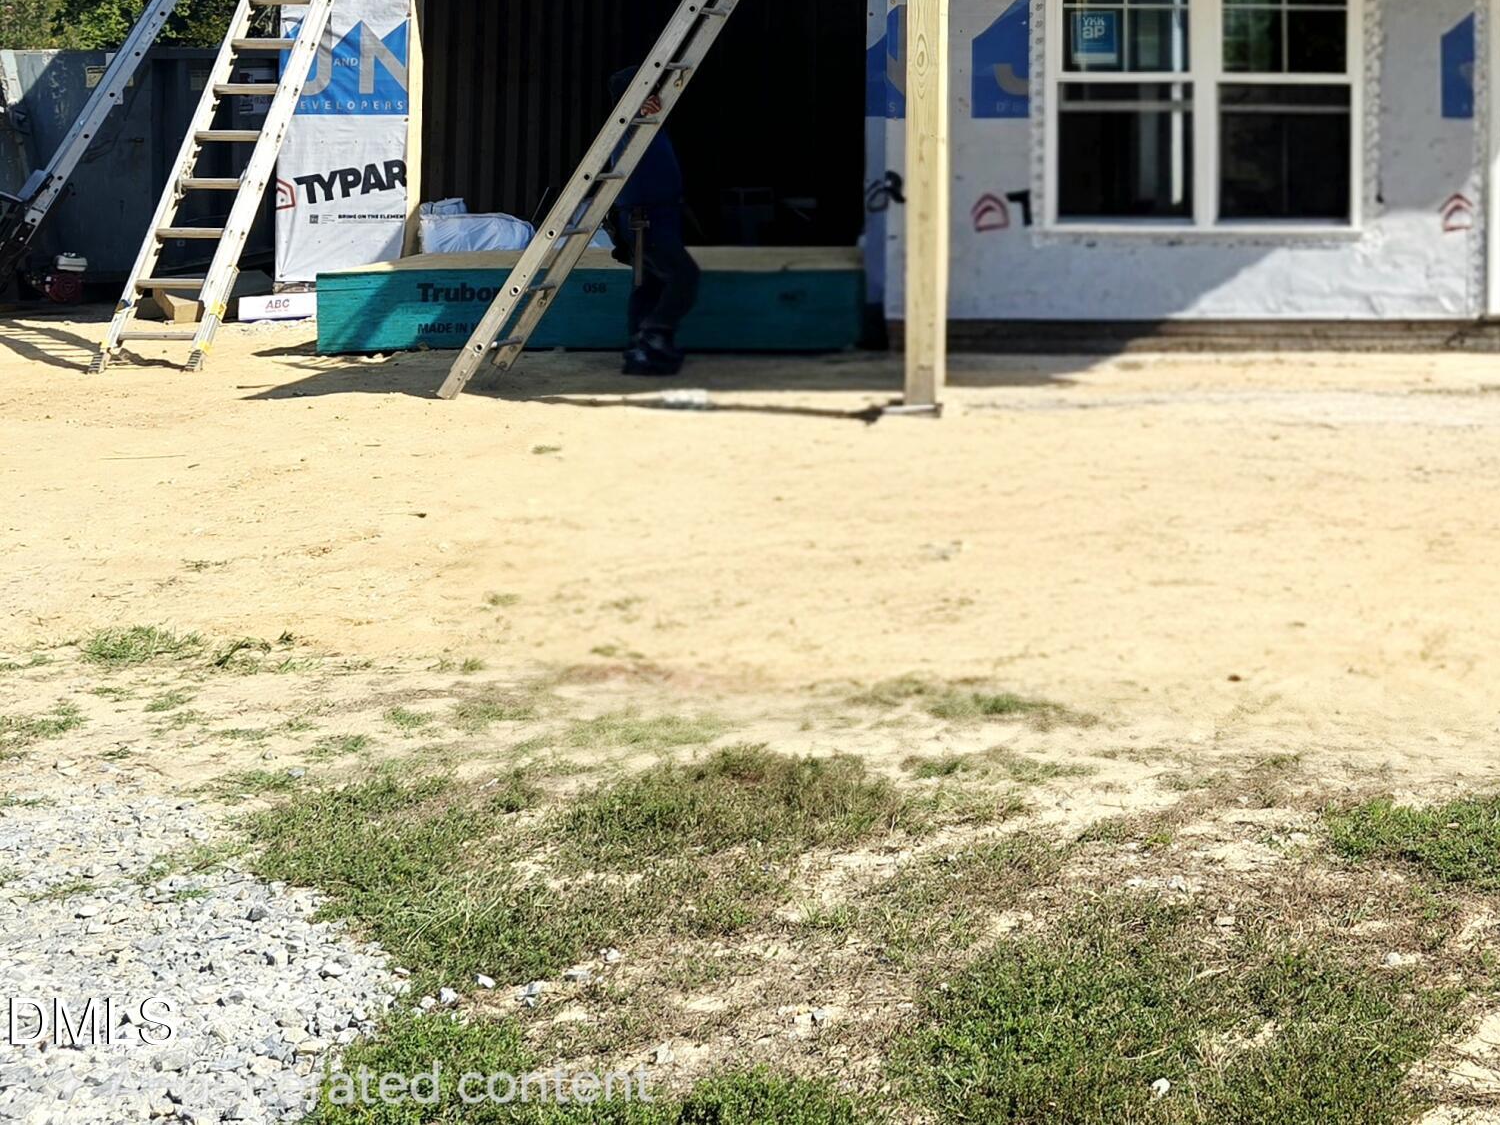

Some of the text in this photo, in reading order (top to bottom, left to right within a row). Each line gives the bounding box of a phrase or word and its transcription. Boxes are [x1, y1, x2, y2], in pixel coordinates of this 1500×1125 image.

[334, 57, 358, 66] AND
[301, 101, 403, 110] EVELOPERS
[293, 159, 407, 204] TYPAR
[583, 282, 608, 295] OSB
[265, 299, 290, 310] ABC
[417, 323, 452, 335] MADE
[454, 323, 468, 335] IN
